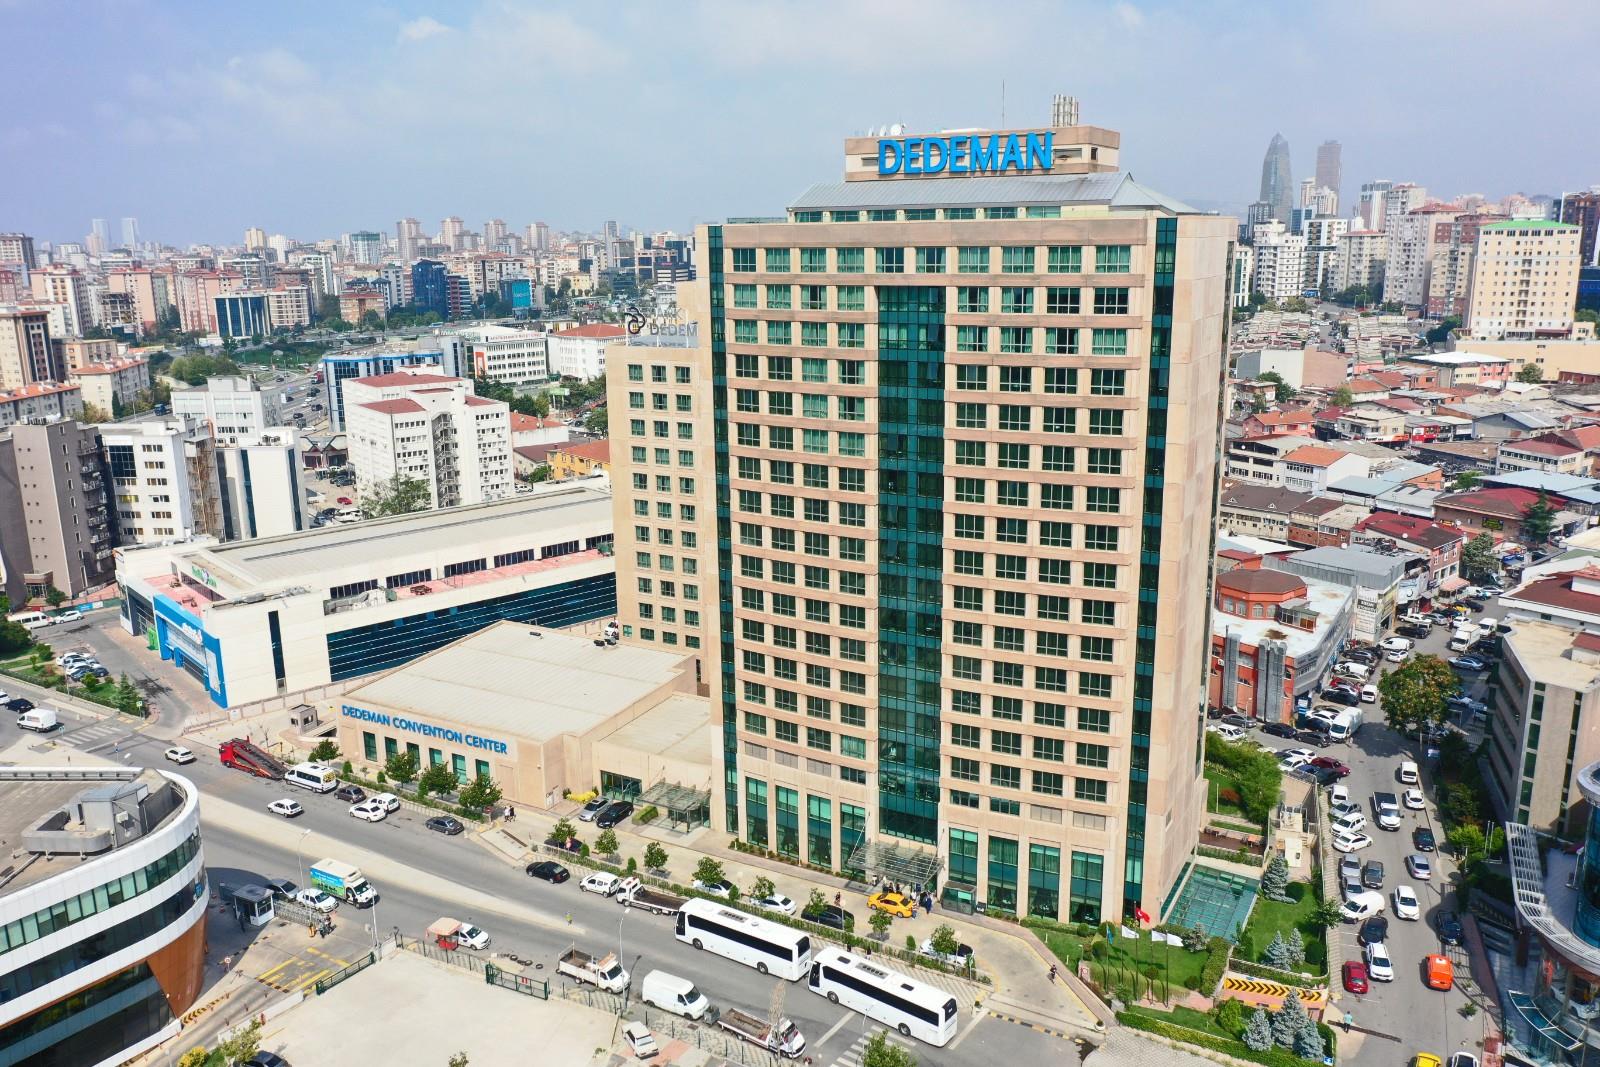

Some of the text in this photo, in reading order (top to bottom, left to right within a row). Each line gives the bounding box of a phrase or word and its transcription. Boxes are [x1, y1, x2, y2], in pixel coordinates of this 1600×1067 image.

[878, 131, 1054, 175] DEDEMAN
[650, 323, 698, 336] DEDEM
[342, 704, 508, 754] DEDEMAN CONVENTION CENTER
